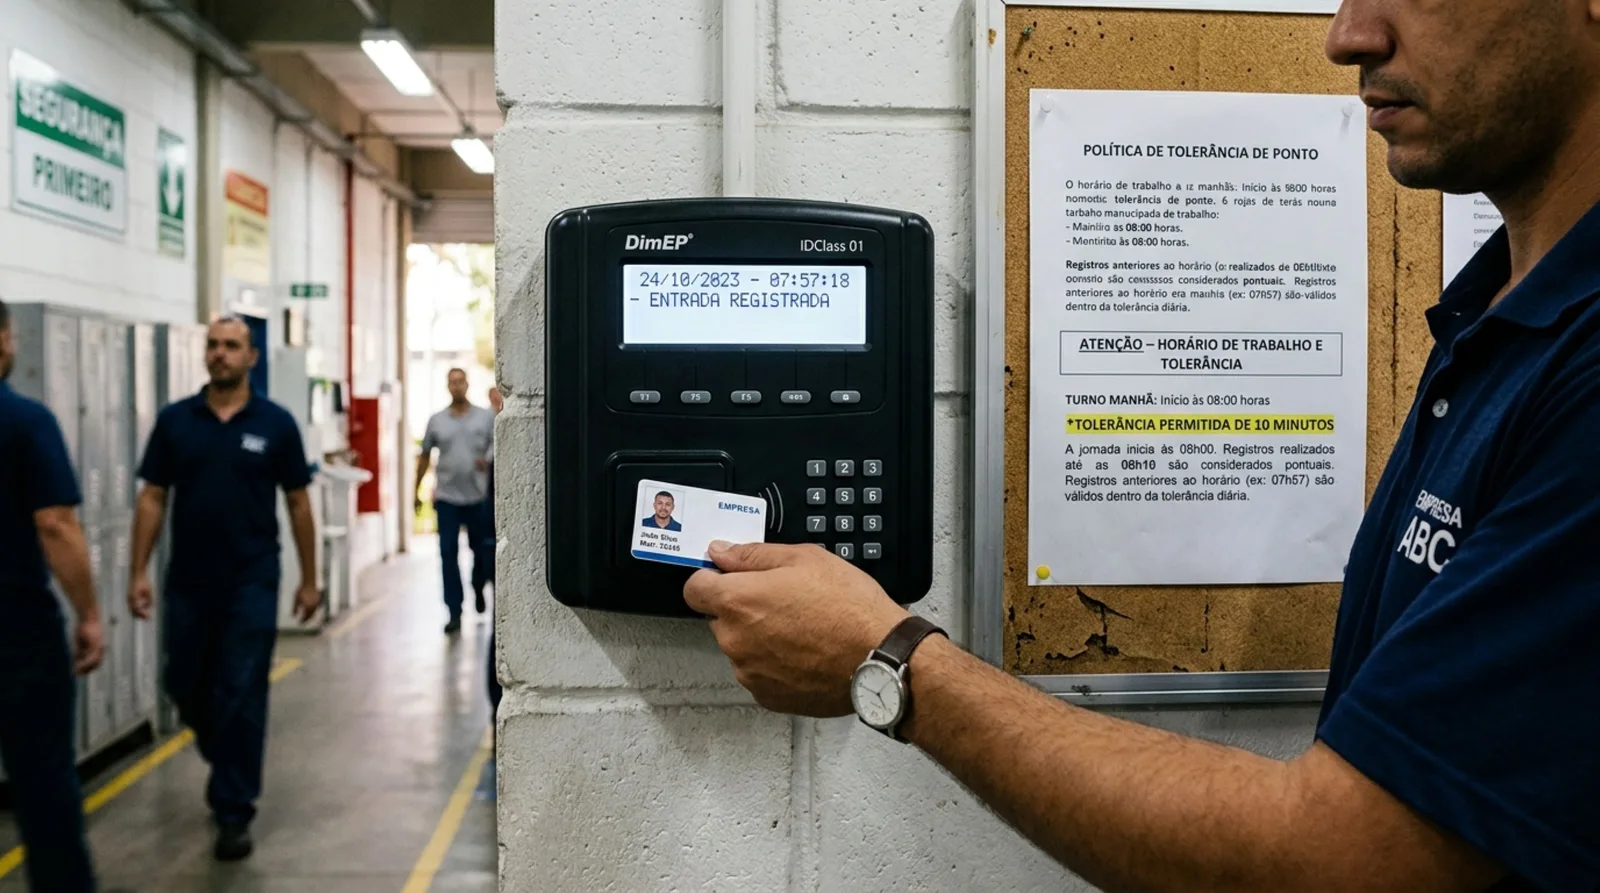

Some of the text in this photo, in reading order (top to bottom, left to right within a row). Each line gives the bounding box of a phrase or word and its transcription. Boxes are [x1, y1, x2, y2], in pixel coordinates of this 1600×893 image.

[1084, 142, 1318, 160] POLÍTICA DE TOLERÂNCIA DE PONTO
[33, 154, 113, 212] PRIMEIRO
[1065, 180, 1074, 189] O
[1116, 181, 1128, 190] de
[1132, 181, 1172, 191] trabalho
[1242, 182, 1267, 192] Início
[1311, 184, 1336, 193] horas
[1167, 195, 1180, 205] de
[1185, 197, 1216, 206] ponte.
[1262, 197, 1274, 206] de
[1163, 209, 1175, 219] de
[1177, 210, 1219, 219] trabalho:
[1125, 223, 1152, 232] 08:00
[1154, 223, 1183, 232] horas.
[800, 240, 863, 252] IDClass 01
[1132, 237, 1158, 246] 08:00
[1160, 237, 1189, 247] horas.
[1066, 260, 1109, 271] Registros
[1112, 261, 1160, 270] anteriores
[1228, 262, 1275, 272] realizados
[1278, 263, 1290, 271] de
[640, 272, 740, 287] 24/10/2023
[769, 272, 850, 288] 07:57:18
[1178, 275, 1239, 285] considerados
[1294, 277, 1336, 288] Registros
[650, 292, 720, 307] ENTRADA
[730, 292, 830, 308] REGISTRADA
[1066, 288, 1114, 297] anteriores
[1118, 290, 1130, 298] ao
[1228, 290, 1246, 300] (ex:
[1065, 302, 1097, 311] dentro
[1099, 302, 1111, 311] da
[1078, 336, 1144, 352] ATENÇÃO
[1158, 336, 1218, 350] HORÁRIO
[1222, 339, 1238, 350] DE
[1242, 339, 1312, 351] TRABALHO
[1316, 339, 1322, 351] E
[1160, 355, 1243, 370] TOLERÂNCIA
[1065, 395, 1106, 405] TURNO
[1109, 392, 1157, 405] MANHÃ:
[1206, 395, 1238, 406] 08:00
[1240, 395, 1270, 406] horas
[1160, 419, 1231, 431] PERMITIDA
[1234, 419, 1251, 431] DE
[1255, 419, 1270, 431] 10
[1274, 419, 1334, 431] MINUTOS
[1064, 444, 1074, 454] A
[1180, 443, 1216, 455] 08h00.
[1223, 443, 1274, 457] Registros
[1280, 443, 1335, 455] realizados
[813, 463, 877, 473] 1 2 3
[1095, 462, 1109, 470] as
[1200, 459, 1273, 470] considerados
[1285, 459, 1334, 472] pontuais.
[1065, 475, 1117, 489] Registros
[1122, 475, 1177, 486] anteriores
[1182, 477, 1197, 486] ao
[1246, 475, 1266, 487] (ex:
[1271, 474, 1310, 487] 07h57)
[813, 491, 821, 501] 4
[869, 491, 877, 501] 6
[1106, 490, 1142, 502] dentro
[1144, 490, 1158, 501] da
[718, 502, 760, 514] EMPRESA
[1415, 490, 1462, 529] EMPRESA
[813, 519, 821, 529] 7
[841, 519, 849, 529] 8
[1397, 516, 1456, 574] ABC
[841, 547, 848, 557] 0
